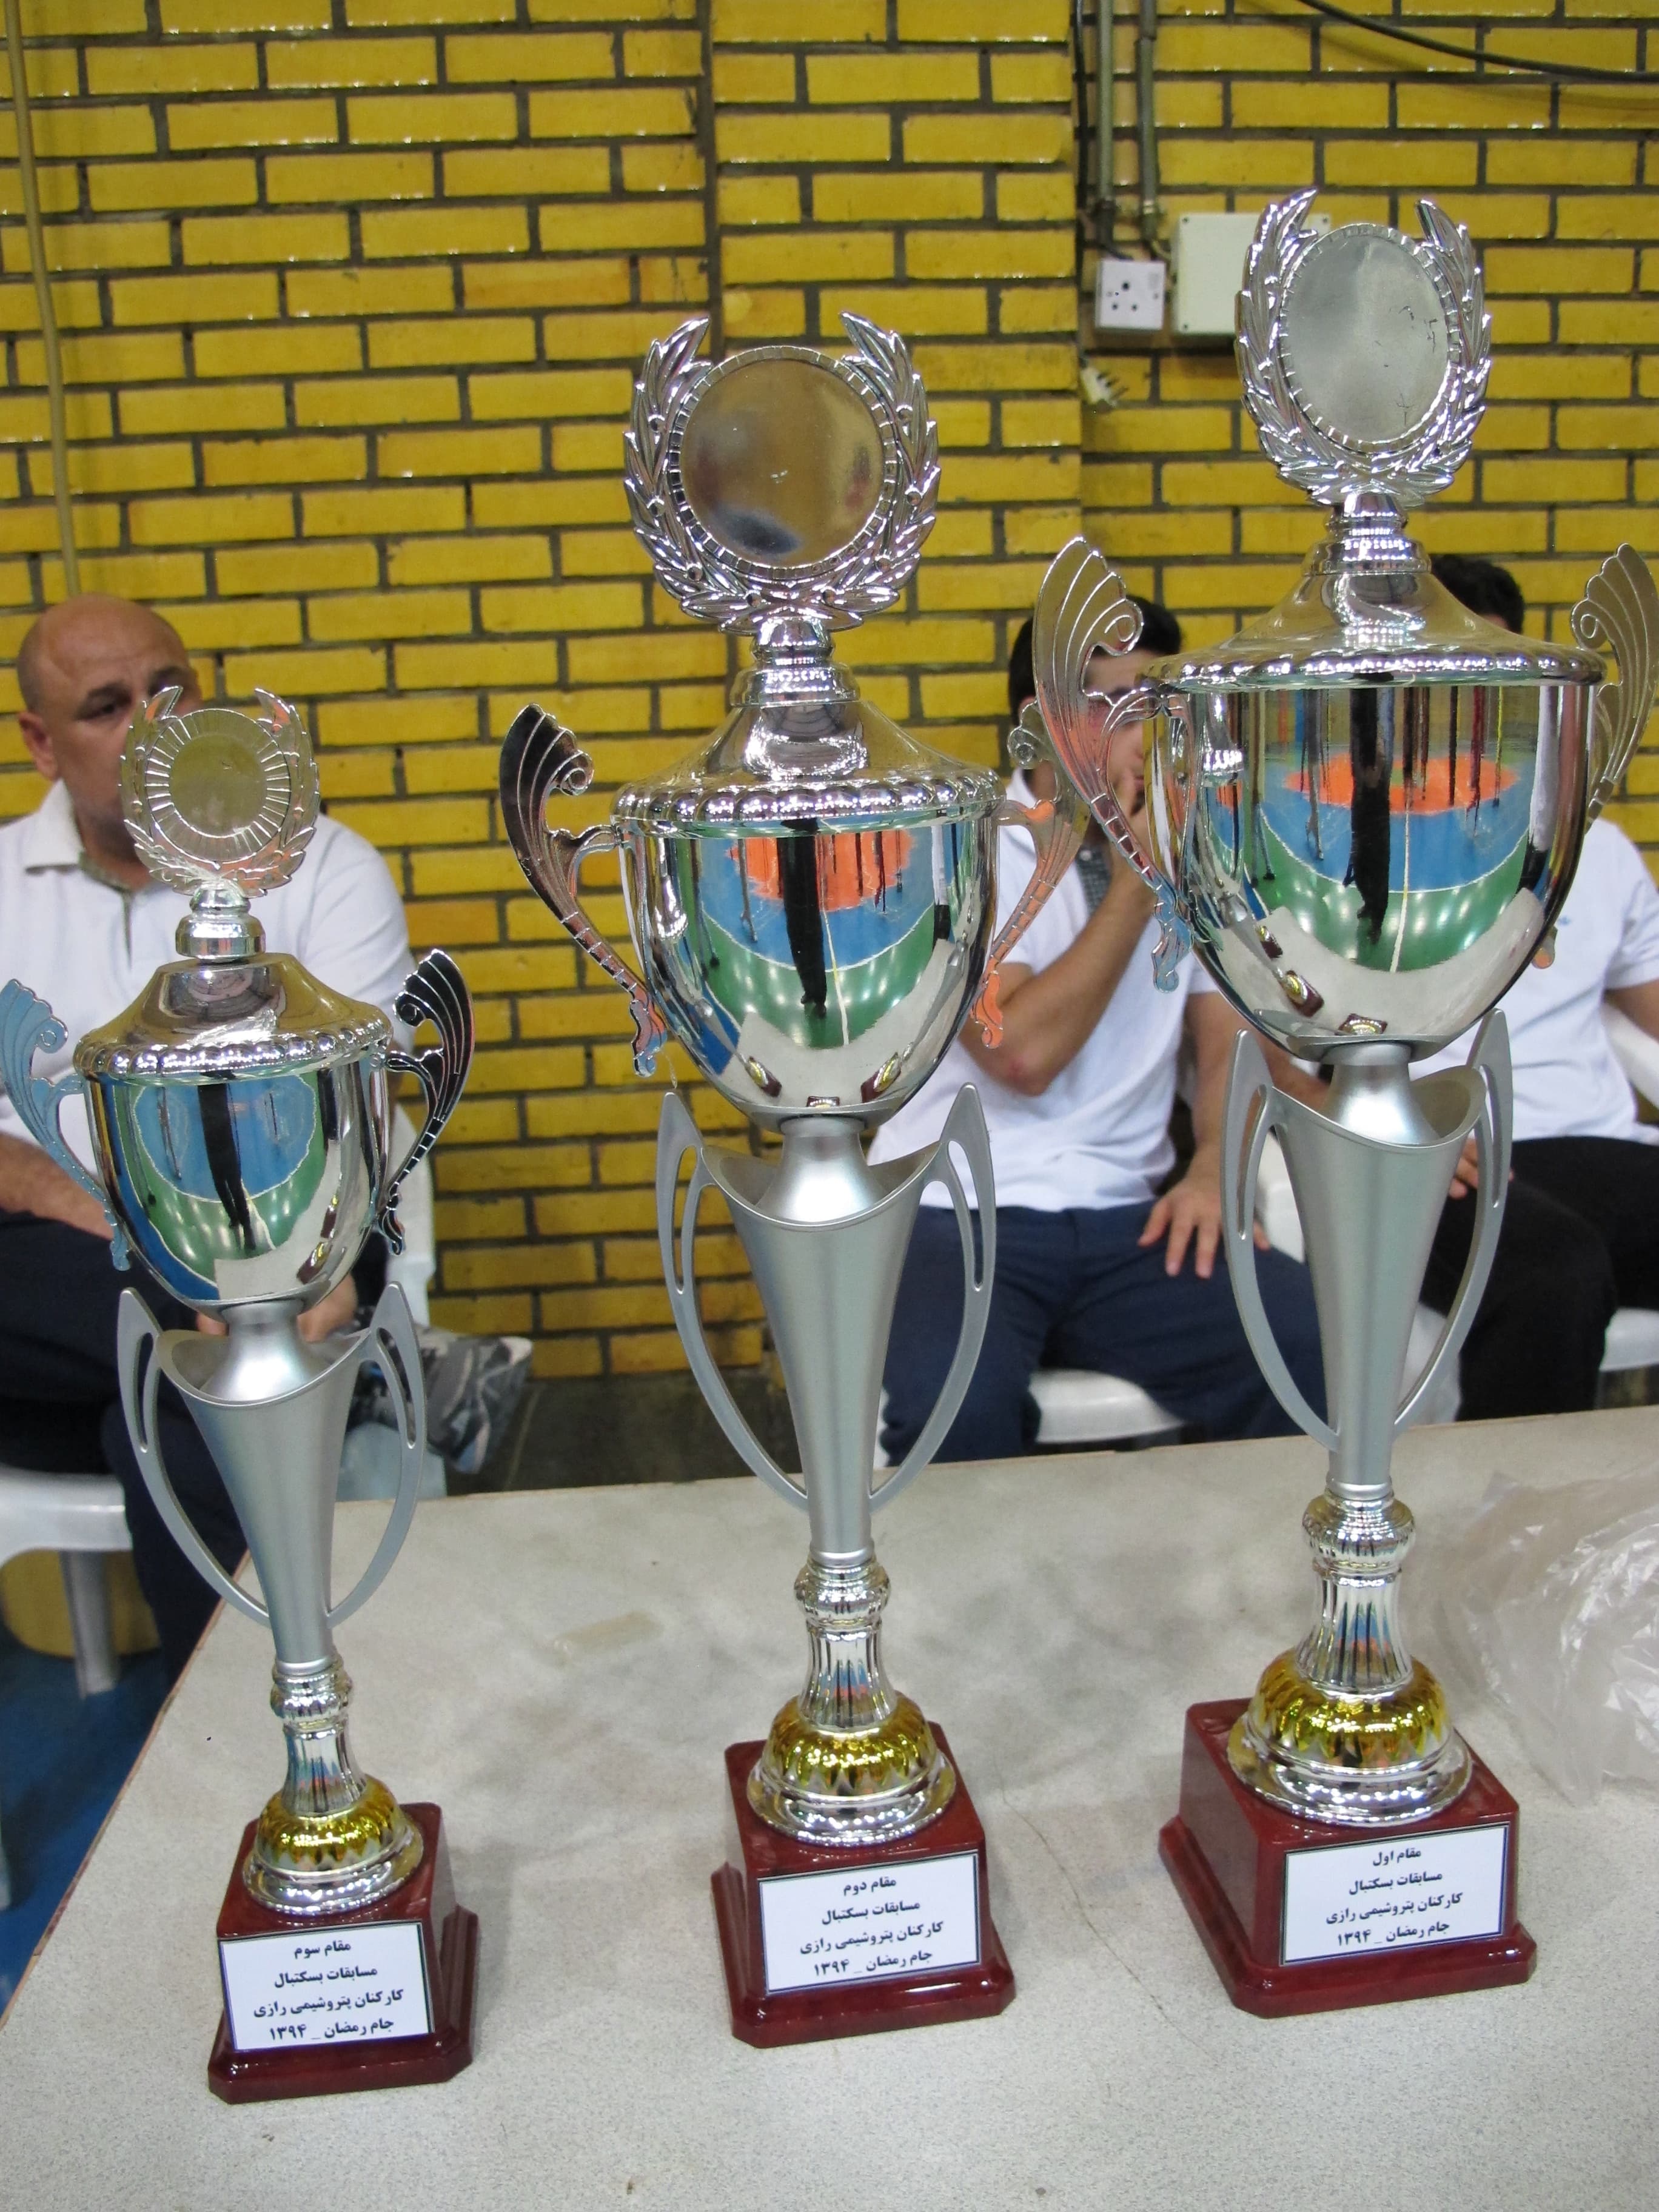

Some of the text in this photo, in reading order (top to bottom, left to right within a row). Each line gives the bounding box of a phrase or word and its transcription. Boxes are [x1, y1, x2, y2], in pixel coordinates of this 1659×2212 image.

[1373, 1848, 1421, 1866] مقام اول
[843, 1877, 896, 1895] مقام دوم
[1349, 1871, 1443, 1895] مسابقات بسکتبال
[822, 1901, 920, 1925] مسابقات بسکتبال
[1326, 1892, 1463, 1925] کارکنان پتروشیمی رازی
[1386, 1926, 1424, 1942] رمضان
[1427, 1921, 1450, 1936] جام
[800, 1922, 943, 1955] کارکنان پتروشیمی رازی
[1338, 1930, 1372, 1946] ۱۳۹۴
[295, 1940, 351, 1959] مقام سوم
[910, 1950, 933, 1965] جام
[814, 1960, 850, 1976] ۱۳۹۴
[866, 1956, 906, 1971] رمضان
[274, 1966, 378, 1988] مسابقات بسکتبال
[253, 1989, 404, 2018] کارکنان پتروشیمی رازی
[269, 2025, 307, 2040] ۱۳۹۴
[324, 2022, 366, 2039] رمضان
[370, 2018, 394, 2033] جام
